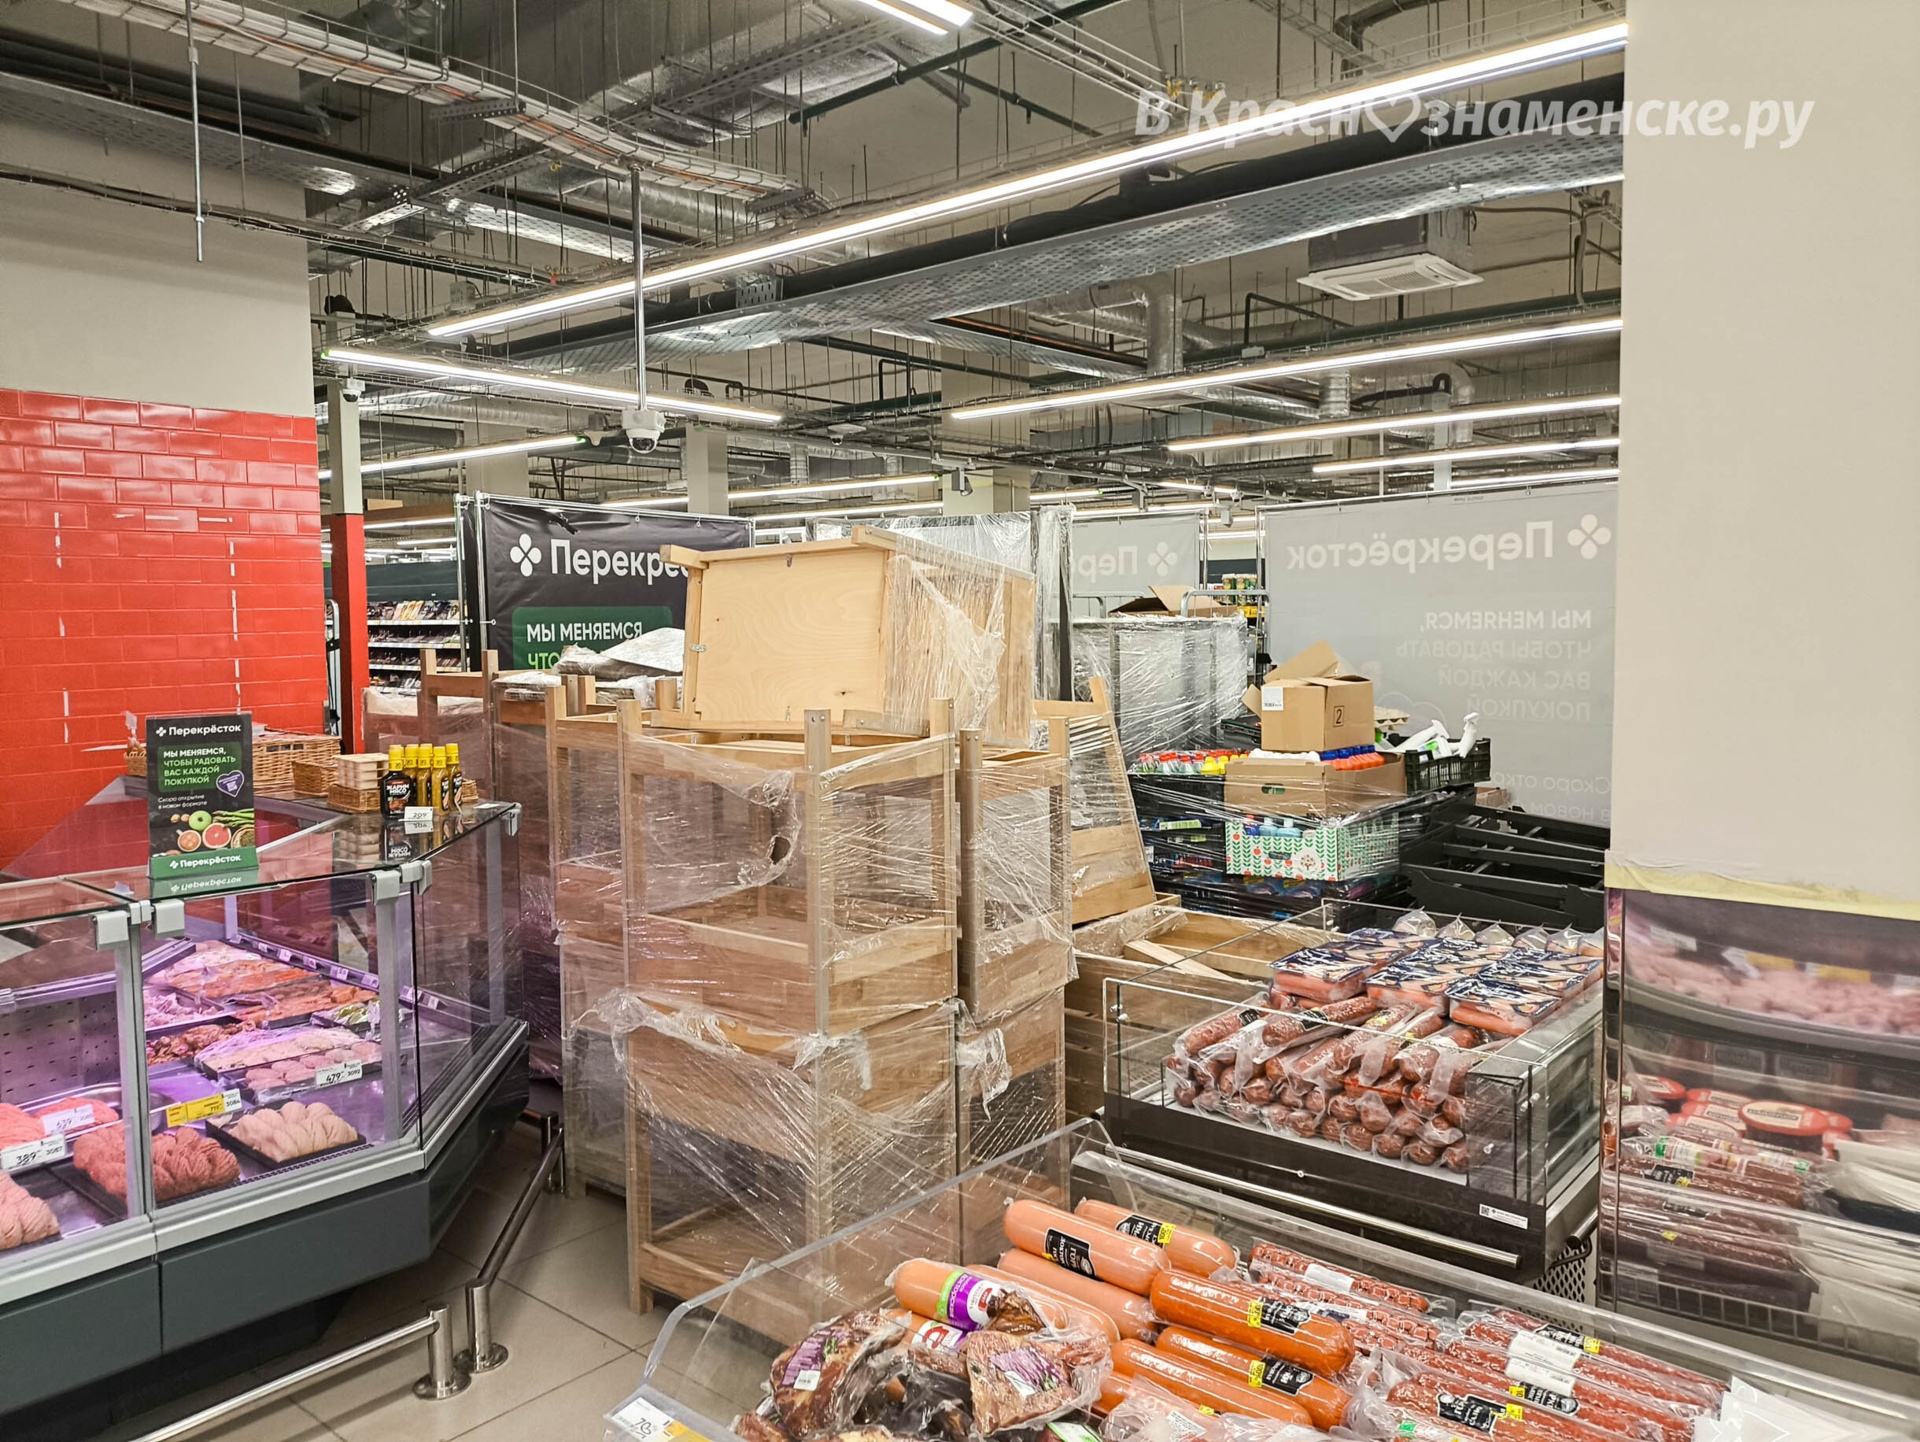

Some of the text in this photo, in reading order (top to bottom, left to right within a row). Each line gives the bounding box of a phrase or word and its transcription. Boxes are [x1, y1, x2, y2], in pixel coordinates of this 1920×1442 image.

[526, 623, 555, 642] МЫ
[168, 725, 242, 737] Перекрёсток
[163, 750, 177, 758] МЫ
[163, 756, 236, 767] ЧТОБЫ РАДОВАТЬ
[164, 765, 220, 777] ВАС КАЖДОЙ
[164, 775, 210, 786] ПОКУПКОЙ
[180, 854, 242, 868] Перекрёсток
